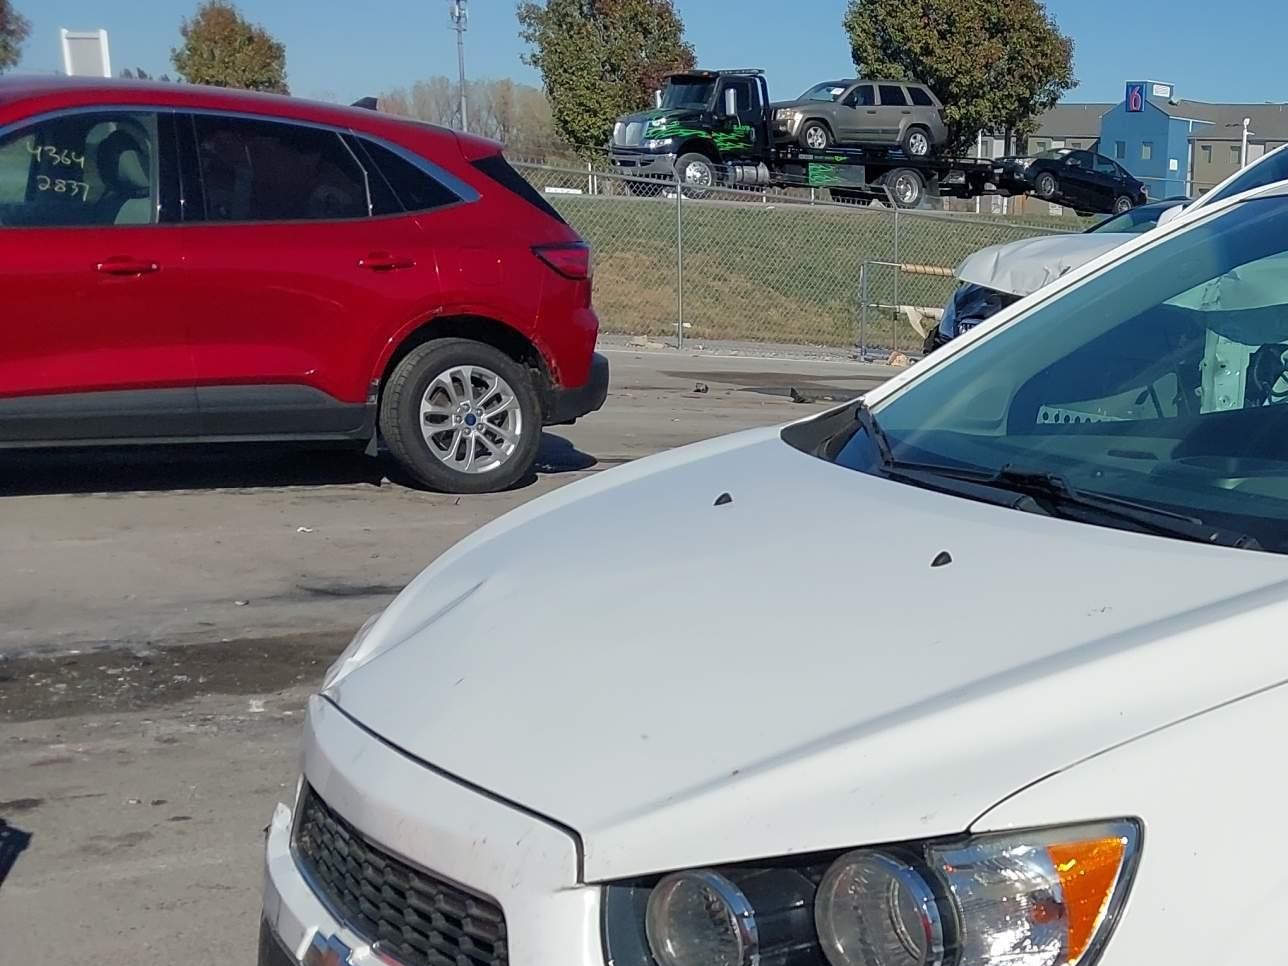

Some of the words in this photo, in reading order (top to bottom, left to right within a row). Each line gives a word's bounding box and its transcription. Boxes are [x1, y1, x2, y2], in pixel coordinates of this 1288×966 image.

[1129, 86, 1142, 111] 6
[26, 141, 86, 169] 4364
[36, 175, 90, 203] 2837
